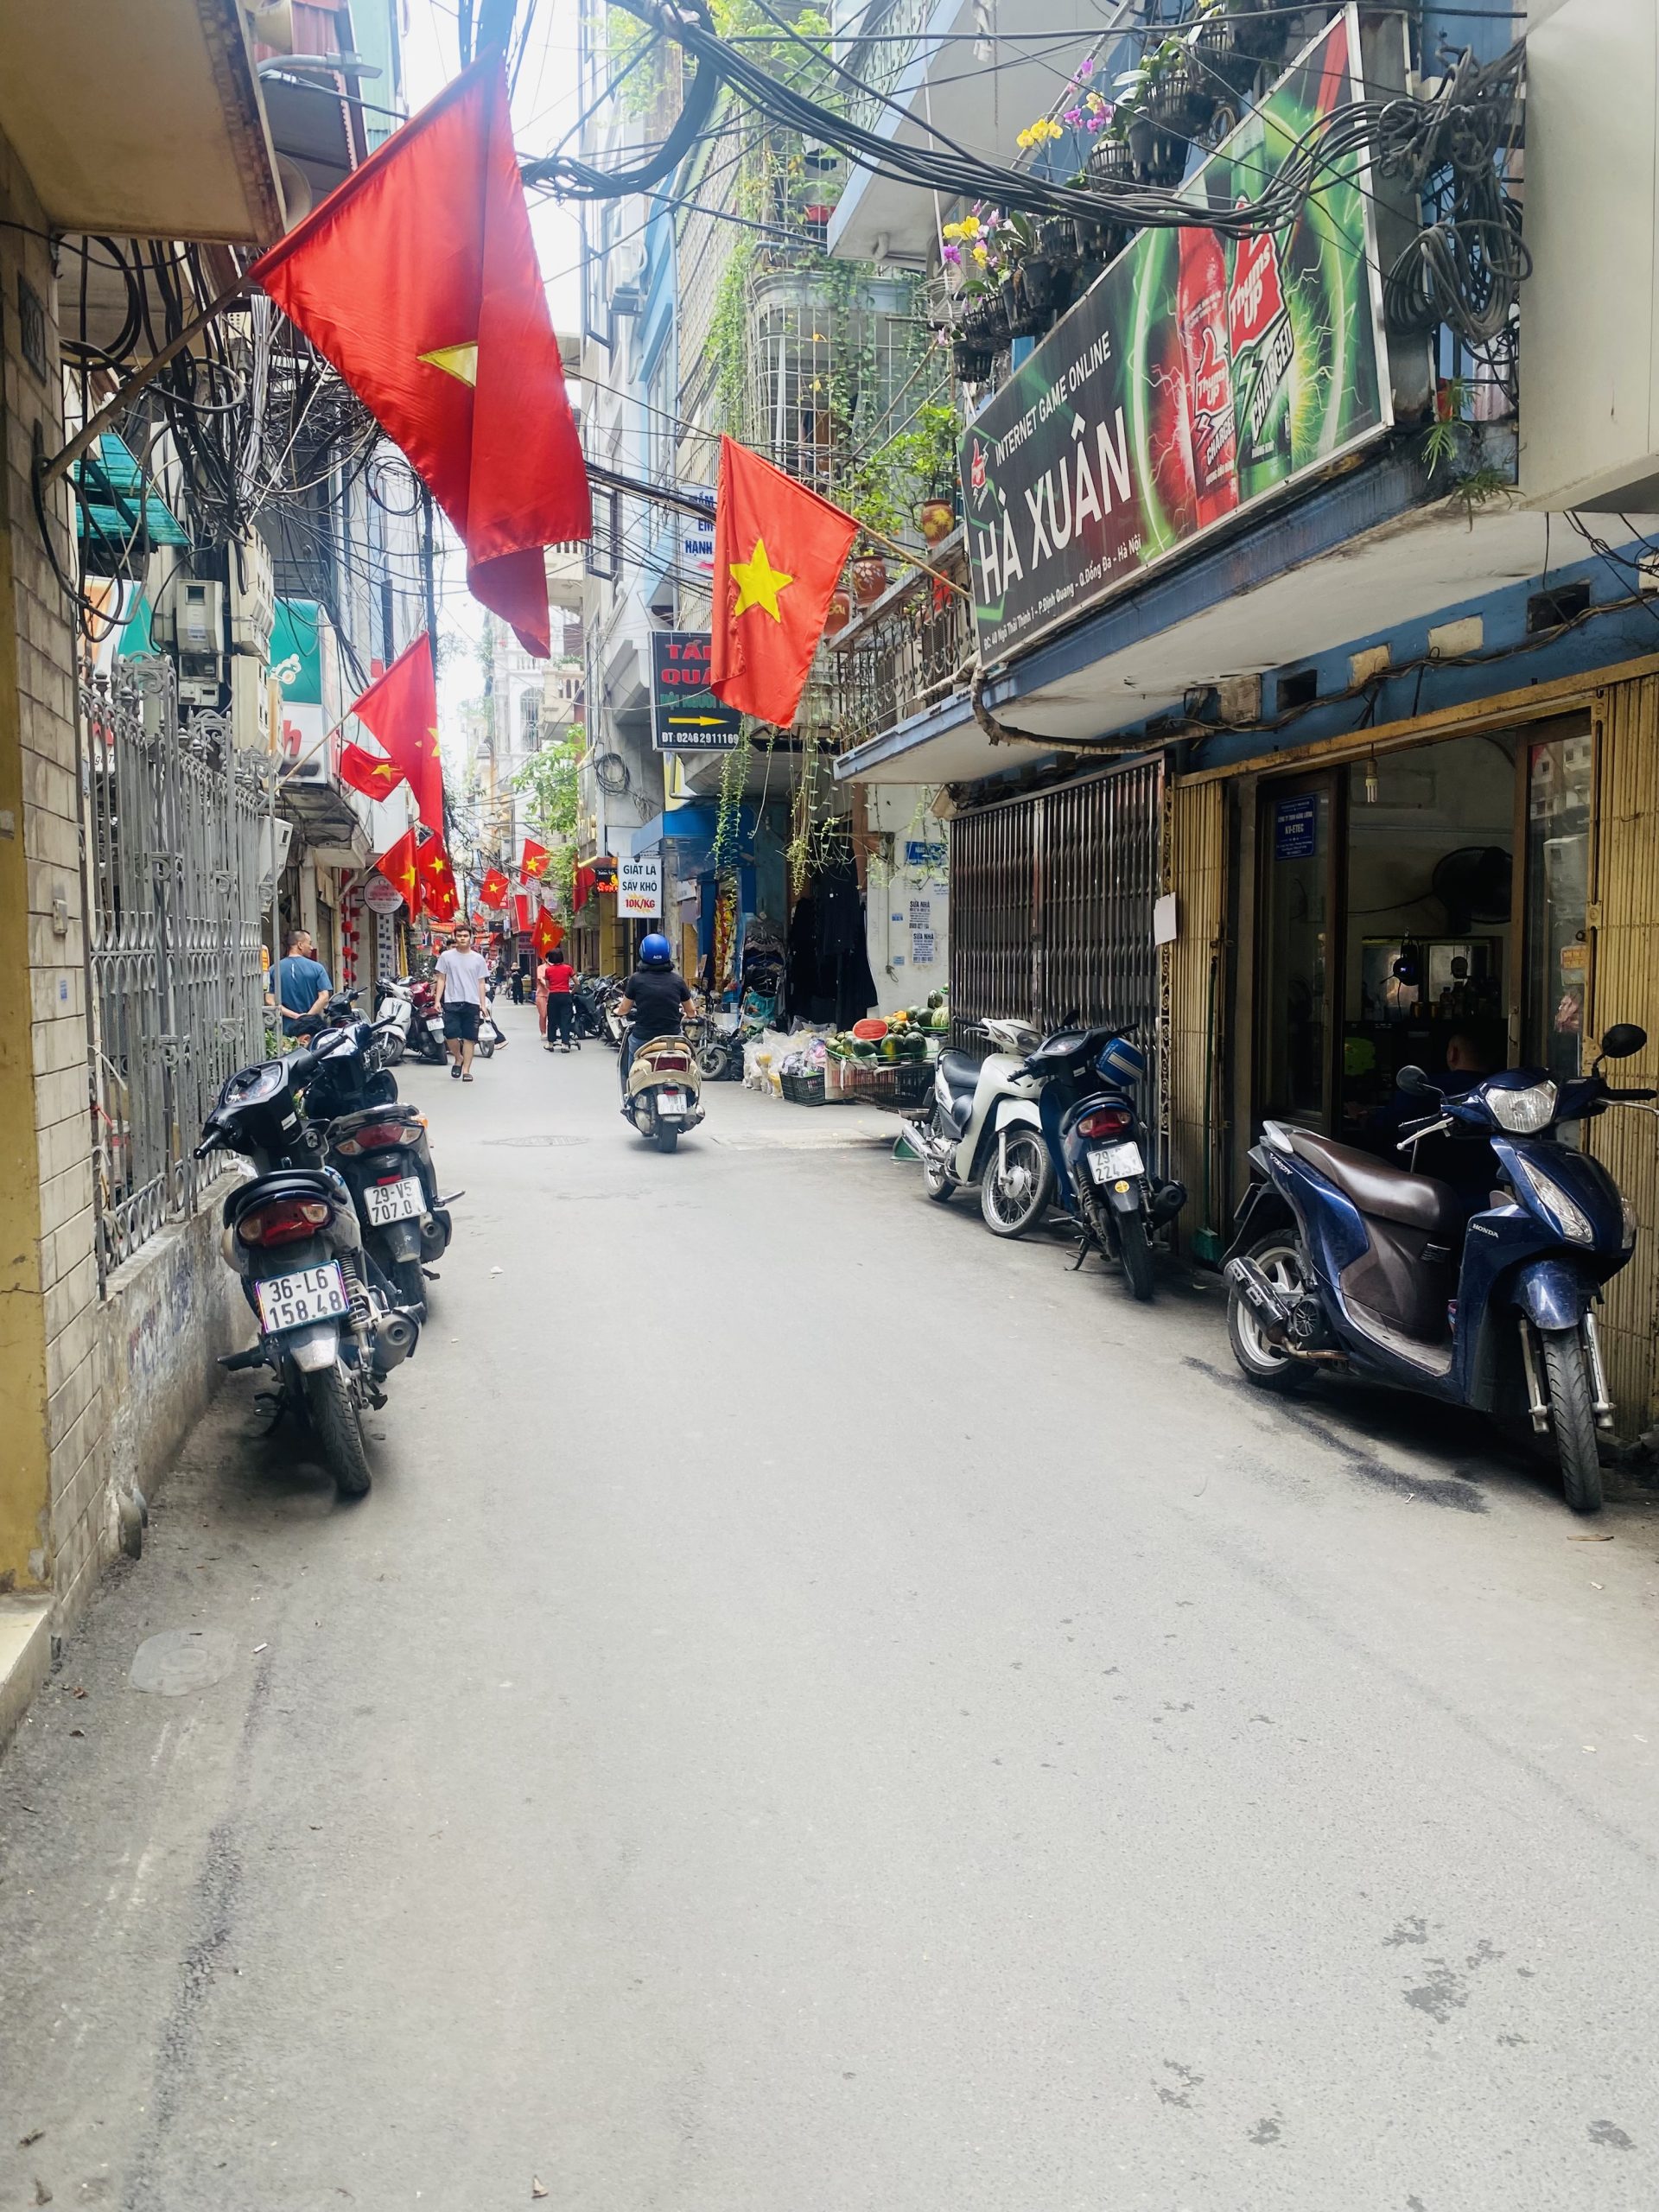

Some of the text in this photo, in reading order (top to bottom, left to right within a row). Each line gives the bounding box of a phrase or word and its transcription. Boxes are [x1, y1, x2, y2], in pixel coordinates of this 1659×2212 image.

[1230, 242, 1271, 332] Thums
[1244, 278, 1263, 329] UP
[995, 330, 1111, 467] INTERNET GAME ONLINE
[1253, 319, 1294, 442] CHARGED
[978, 406, 1132, 604] HÀ XUÂN
[685, 540, 713, 556] HẠNH
[1056, 582, 1075, 603] Quang
[1102, 556, 1112, 570] Đa
[1117, 543, 1128, 562] Hà
[1128, 532, 1141, 556] Nội
[626, 899, 655, 909] 10K/KG
[373, 1181, 412, 1205] 29-V5
[1472, 1224, 1499, 1238] HONDA
[269, 1268, 328, 1302] 36-L6
[270, 1290, 342, 1329] 158.48
